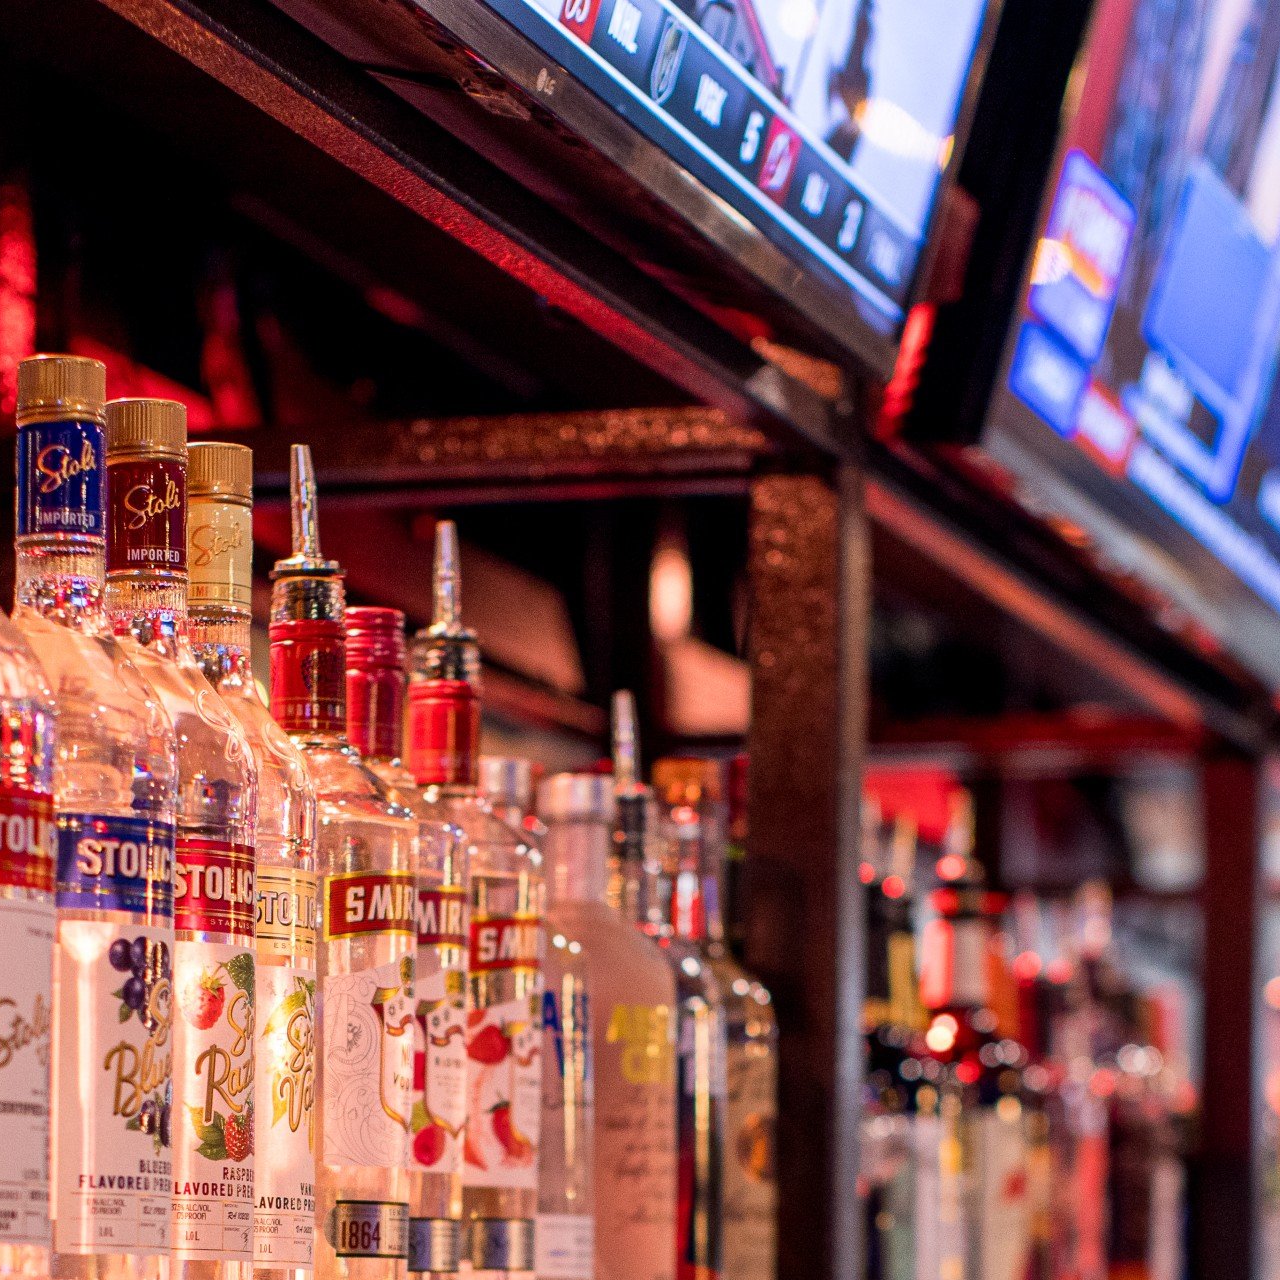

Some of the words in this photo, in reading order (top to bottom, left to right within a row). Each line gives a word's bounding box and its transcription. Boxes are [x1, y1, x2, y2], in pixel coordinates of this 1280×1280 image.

[740, 111, 765, 164] 5
[37, 437, 96, 493] Stoli
[39, 511, 95, 528] IMPORTED
[124, 480, 181, 530] Stoli
[127, 548, 181, 564] IMPORTED
[190, 521, 243, 568] Stoli
[78, 1174, 150, 1191] FLAVORED
[174, 1182, 234, 1198] LAVORED
[341, 1220, 382, 1251] 1864
